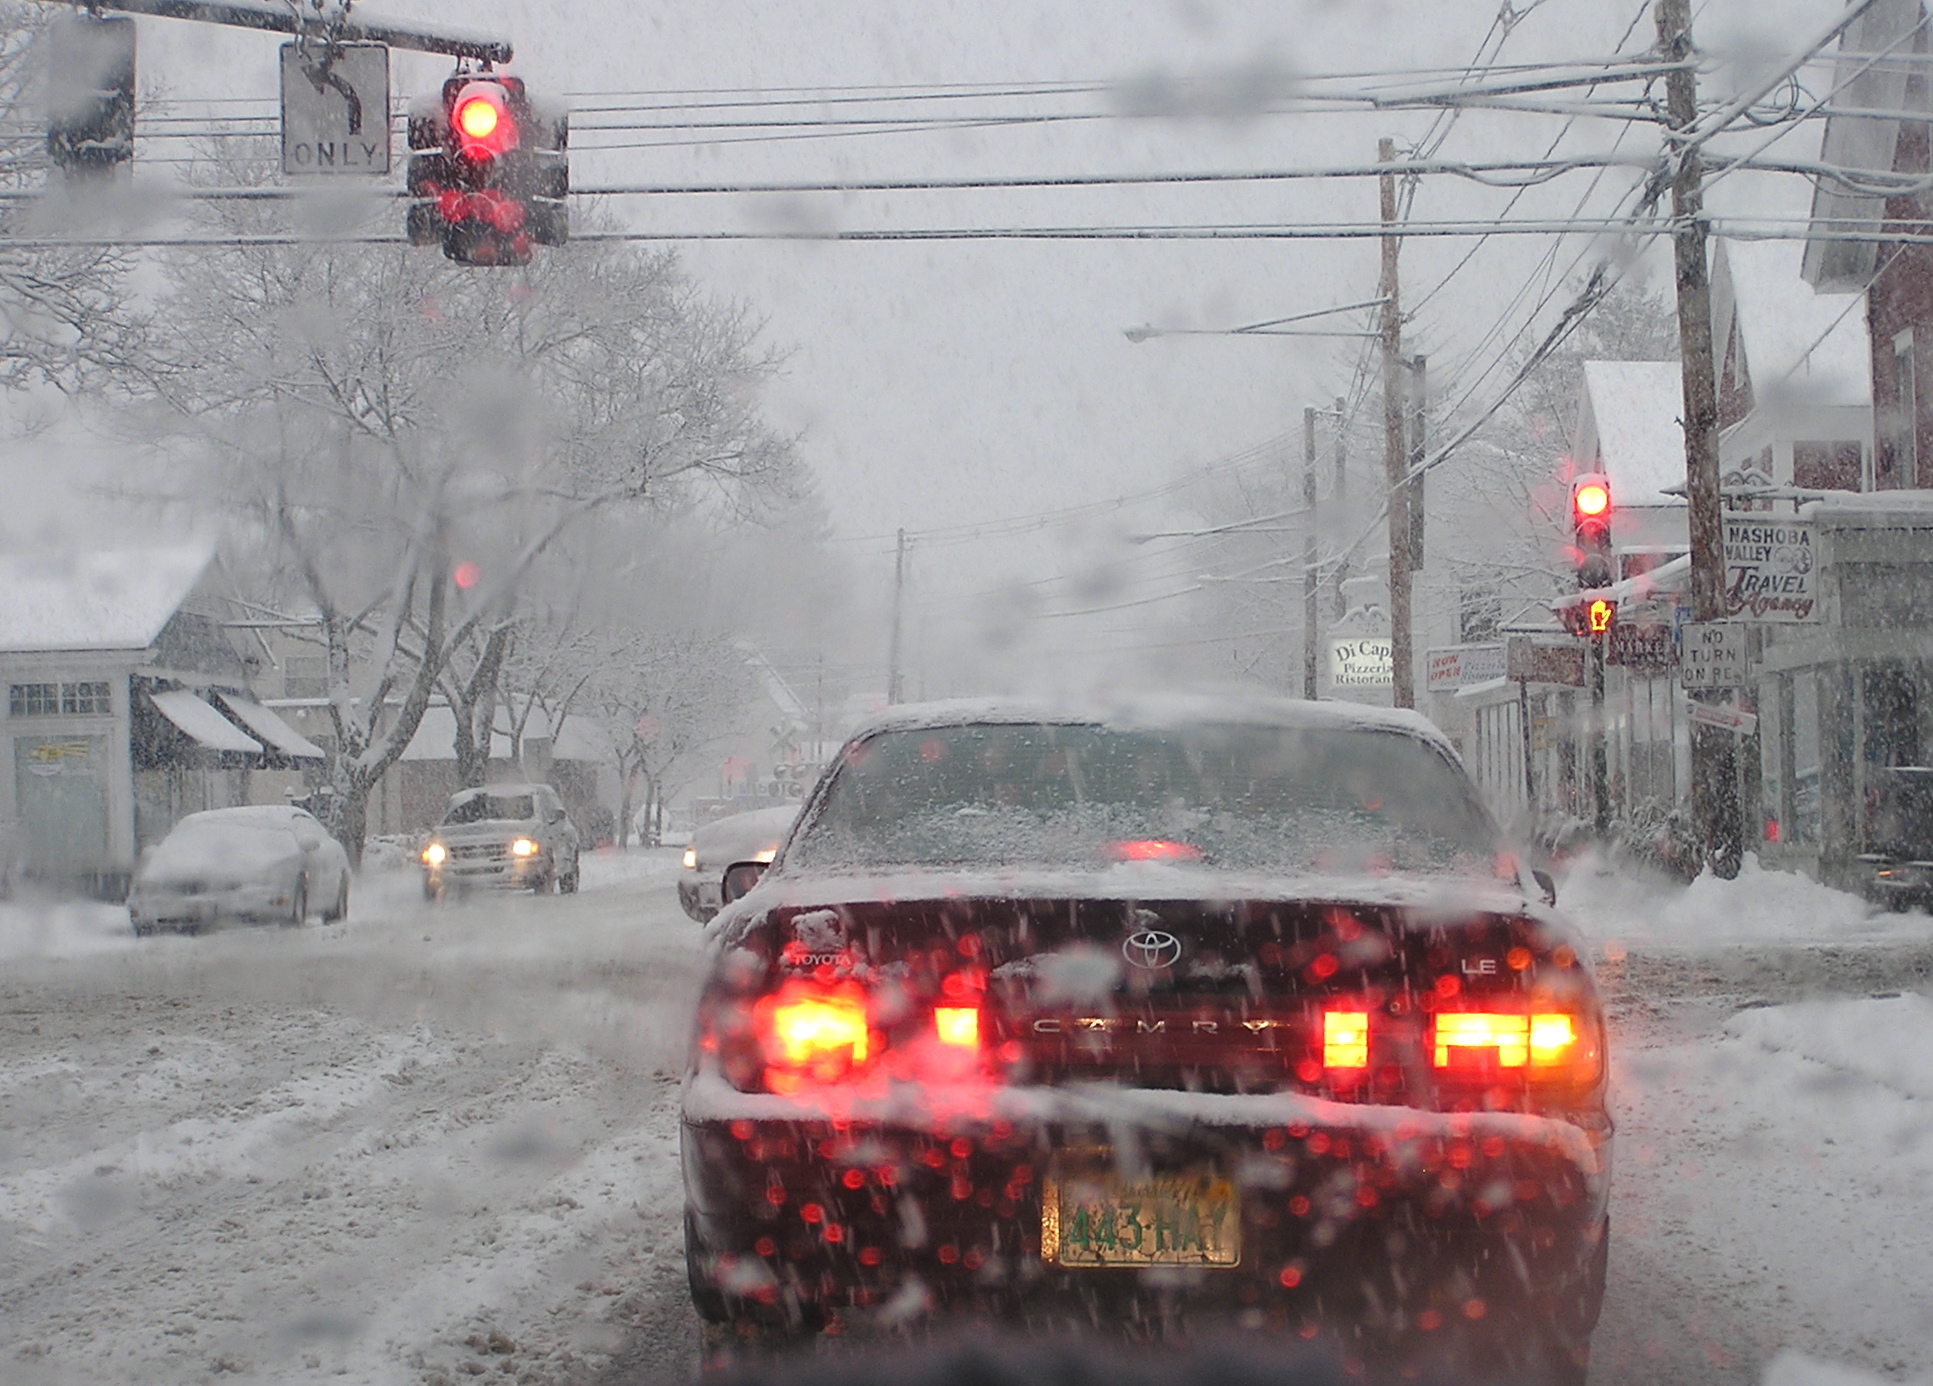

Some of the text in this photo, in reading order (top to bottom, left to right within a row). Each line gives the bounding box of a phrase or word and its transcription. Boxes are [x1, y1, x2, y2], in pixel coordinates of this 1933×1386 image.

[294, 142, 377, 166] ONLY
[1728, 527, 1810, 546] NASHOBA
[1725, 545, 1772, 562] VALLEY
[1726, 565, 1808, 595] TRAVEL
[1702, 630, 1723, 644] NO
[1335, 643, 1356, 661] Di
[1616, 640, 1677, 653] MARKE
[1432, 654, 1459, 668] NOW
[1690, 649, 1736, 662] TURN
[1336, 674, 1394, 684] Ristoran
[1430, 666, 1461, 681] OPEN
[1684, 668, 1742, 683] ON RE
[794, 954, 852, 966] TOYOTA
[1461, 959, 1496, 975] LE
[1033, 1018, 1269, 1035] CAMRY
